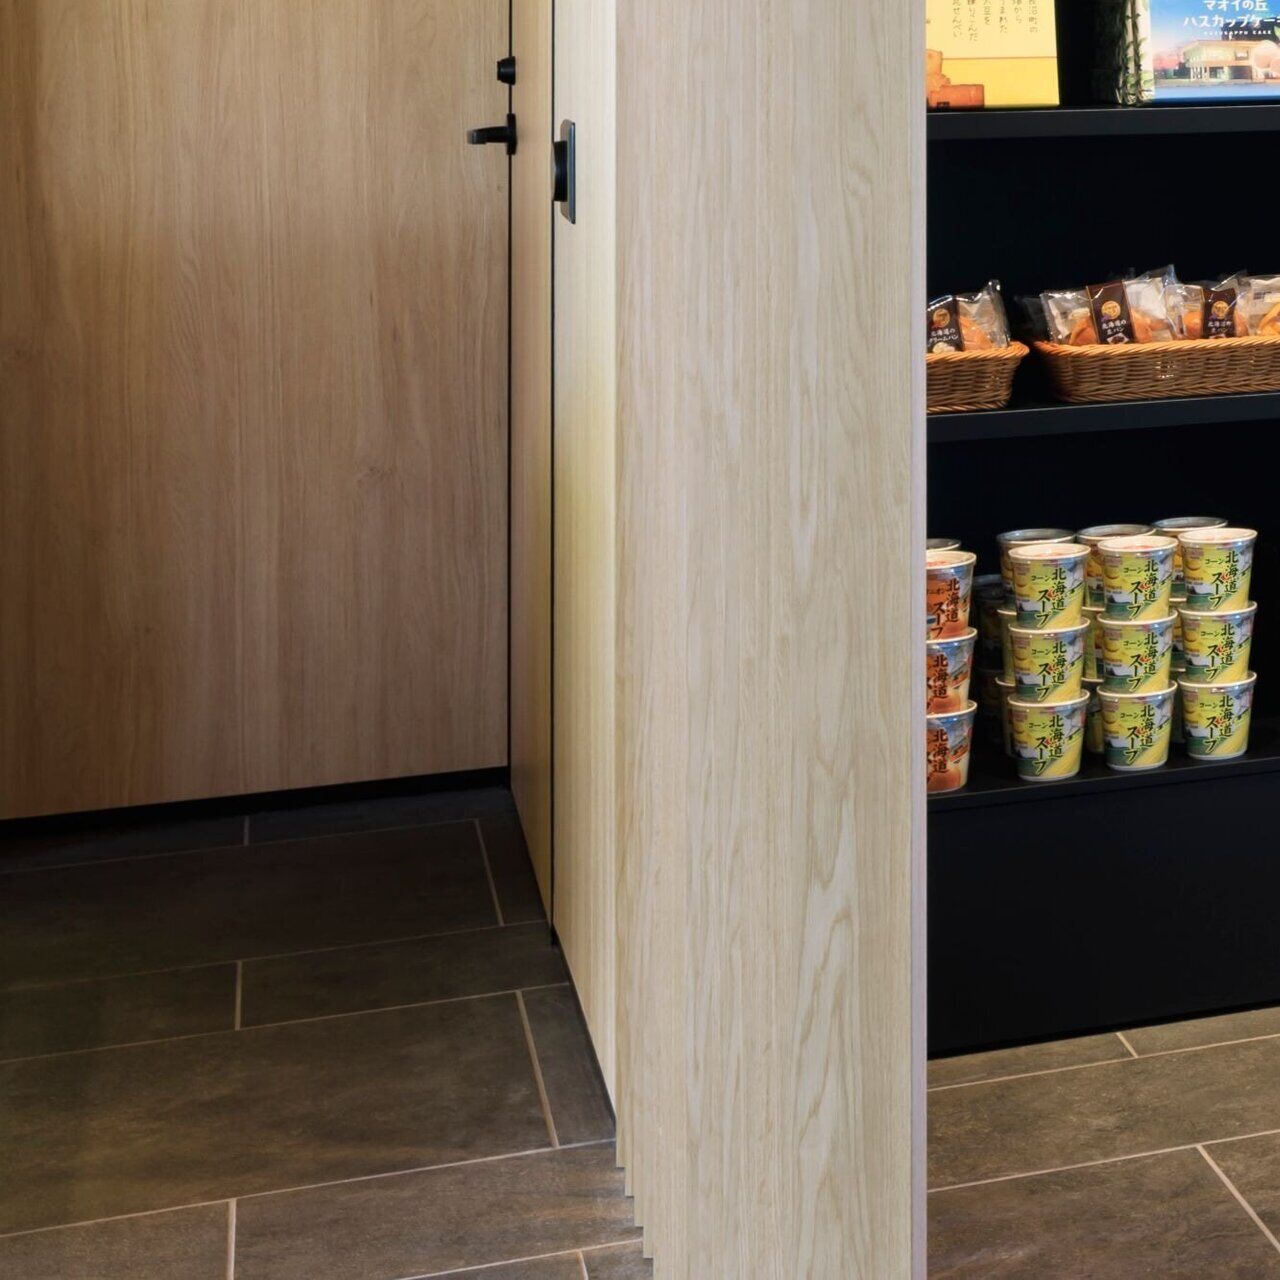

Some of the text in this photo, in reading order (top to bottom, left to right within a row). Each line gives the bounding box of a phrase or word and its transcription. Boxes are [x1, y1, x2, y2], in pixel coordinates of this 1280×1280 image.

[1052, 567, 1067, 611] 北海道
[1123, 566, 1143, 574] コーン
[1143, 559, 1158, 604] 北海道
[1210, 572, 1224, 609] スープ
[1225, 550, 1238, 594] 北海道
[932, 601, 945, 638] スープ
[946, 577, 960, 623] 北海道
[1037, 589, 1051, 628] スープ
[1128, 581, 1143, 619] スープ
[1052, 641, 1067, 685] 北海道
[1143, 632, 1158, 676] 北海道
[1206, 645, 1219, 682] スープ
[1221, 623, 1235, 666] 北海道
[933, 654, 949, 699] 北海道
[1037, 663, 1051, 702] スープ
[1128, 654, 1143, 692] スープ
[1049, 715, 1064, 759] 北海道
[1140, 704, 1155, 748] 北海道
[1205, 717, 1218, 754] スープ
[1219, 695, 1233, 738] 北海道
[933, 728, 949, 773] 北海道
[1034, 736, 1049, 775] スープ
[1125, 726, 1139, 765] スープ
